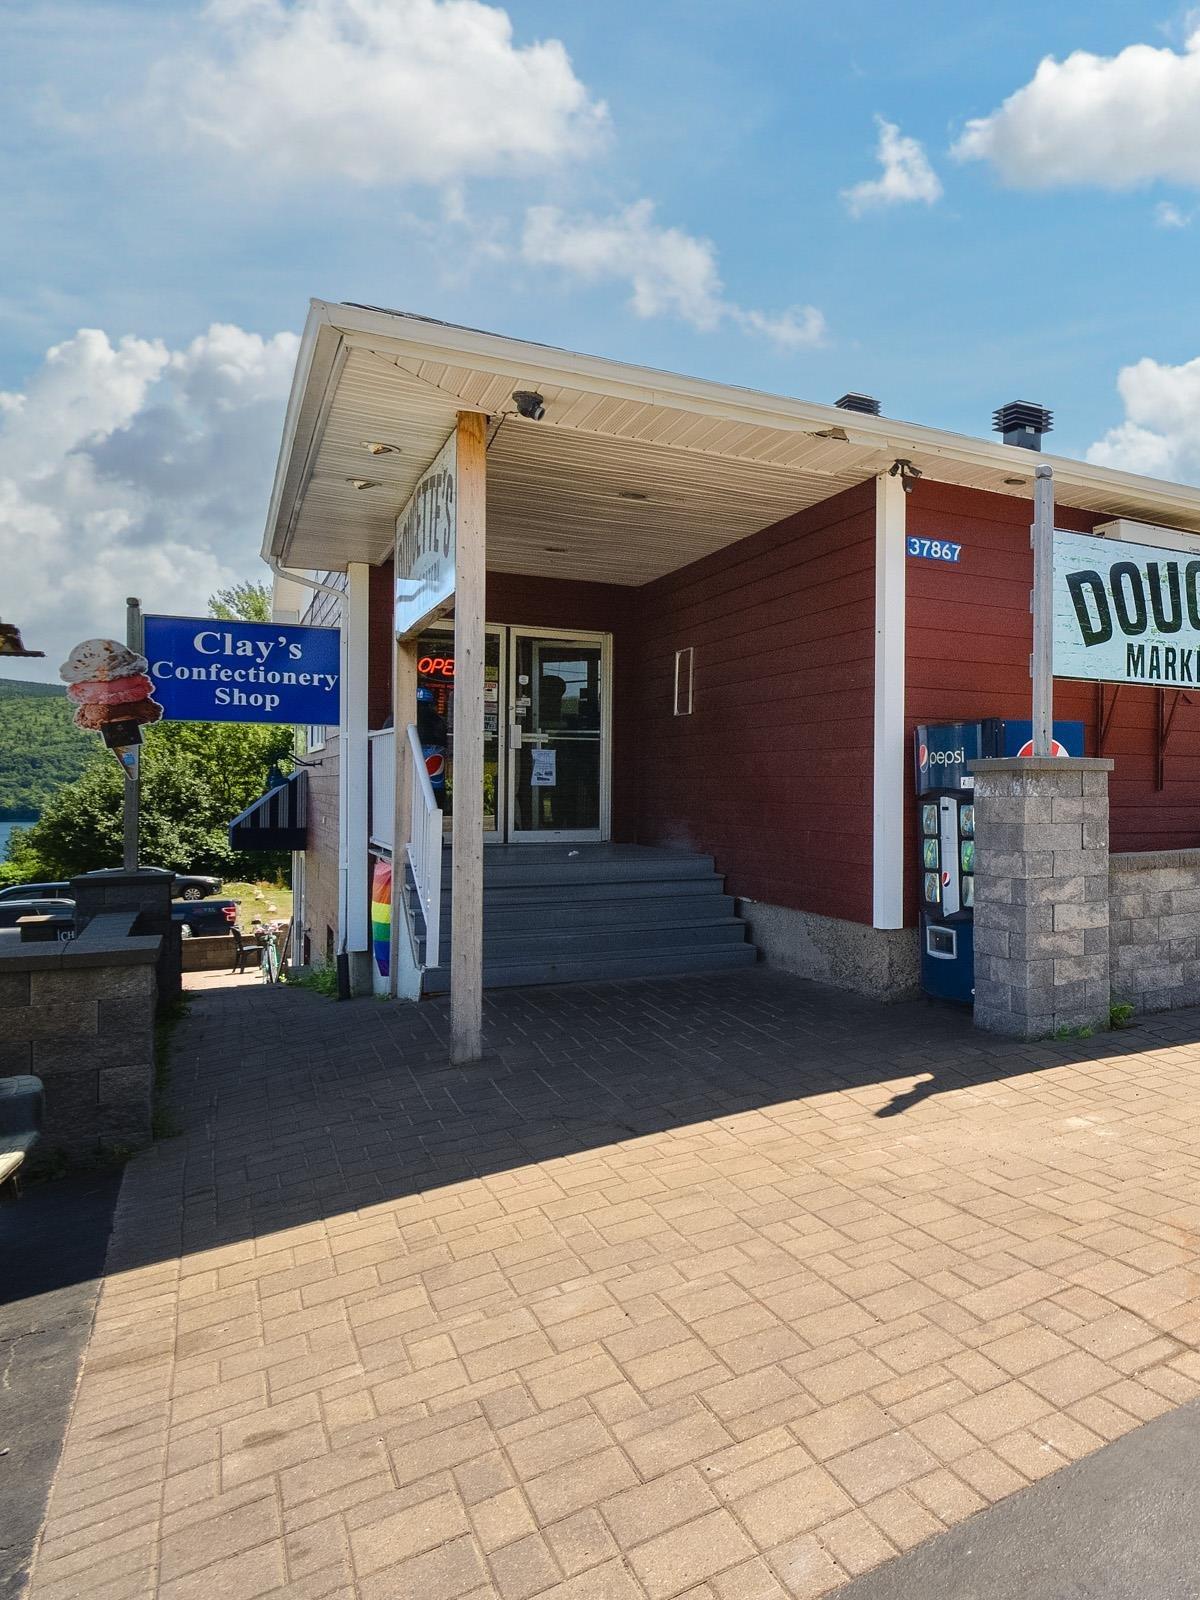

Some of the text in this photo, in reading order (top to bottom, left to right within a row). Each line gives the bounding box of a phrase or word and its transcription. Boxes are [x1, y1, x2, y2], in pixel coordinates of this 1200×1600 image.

[909, 538, 961, 560] 37867
[193, 631, 303, 663] Clay's
[152, 661, 339, 691] Confectionery
[418, 657, 455, 676] OPE
[215, 687, 280, 711] Shop
[929, 747, 965, 768] pepsi
